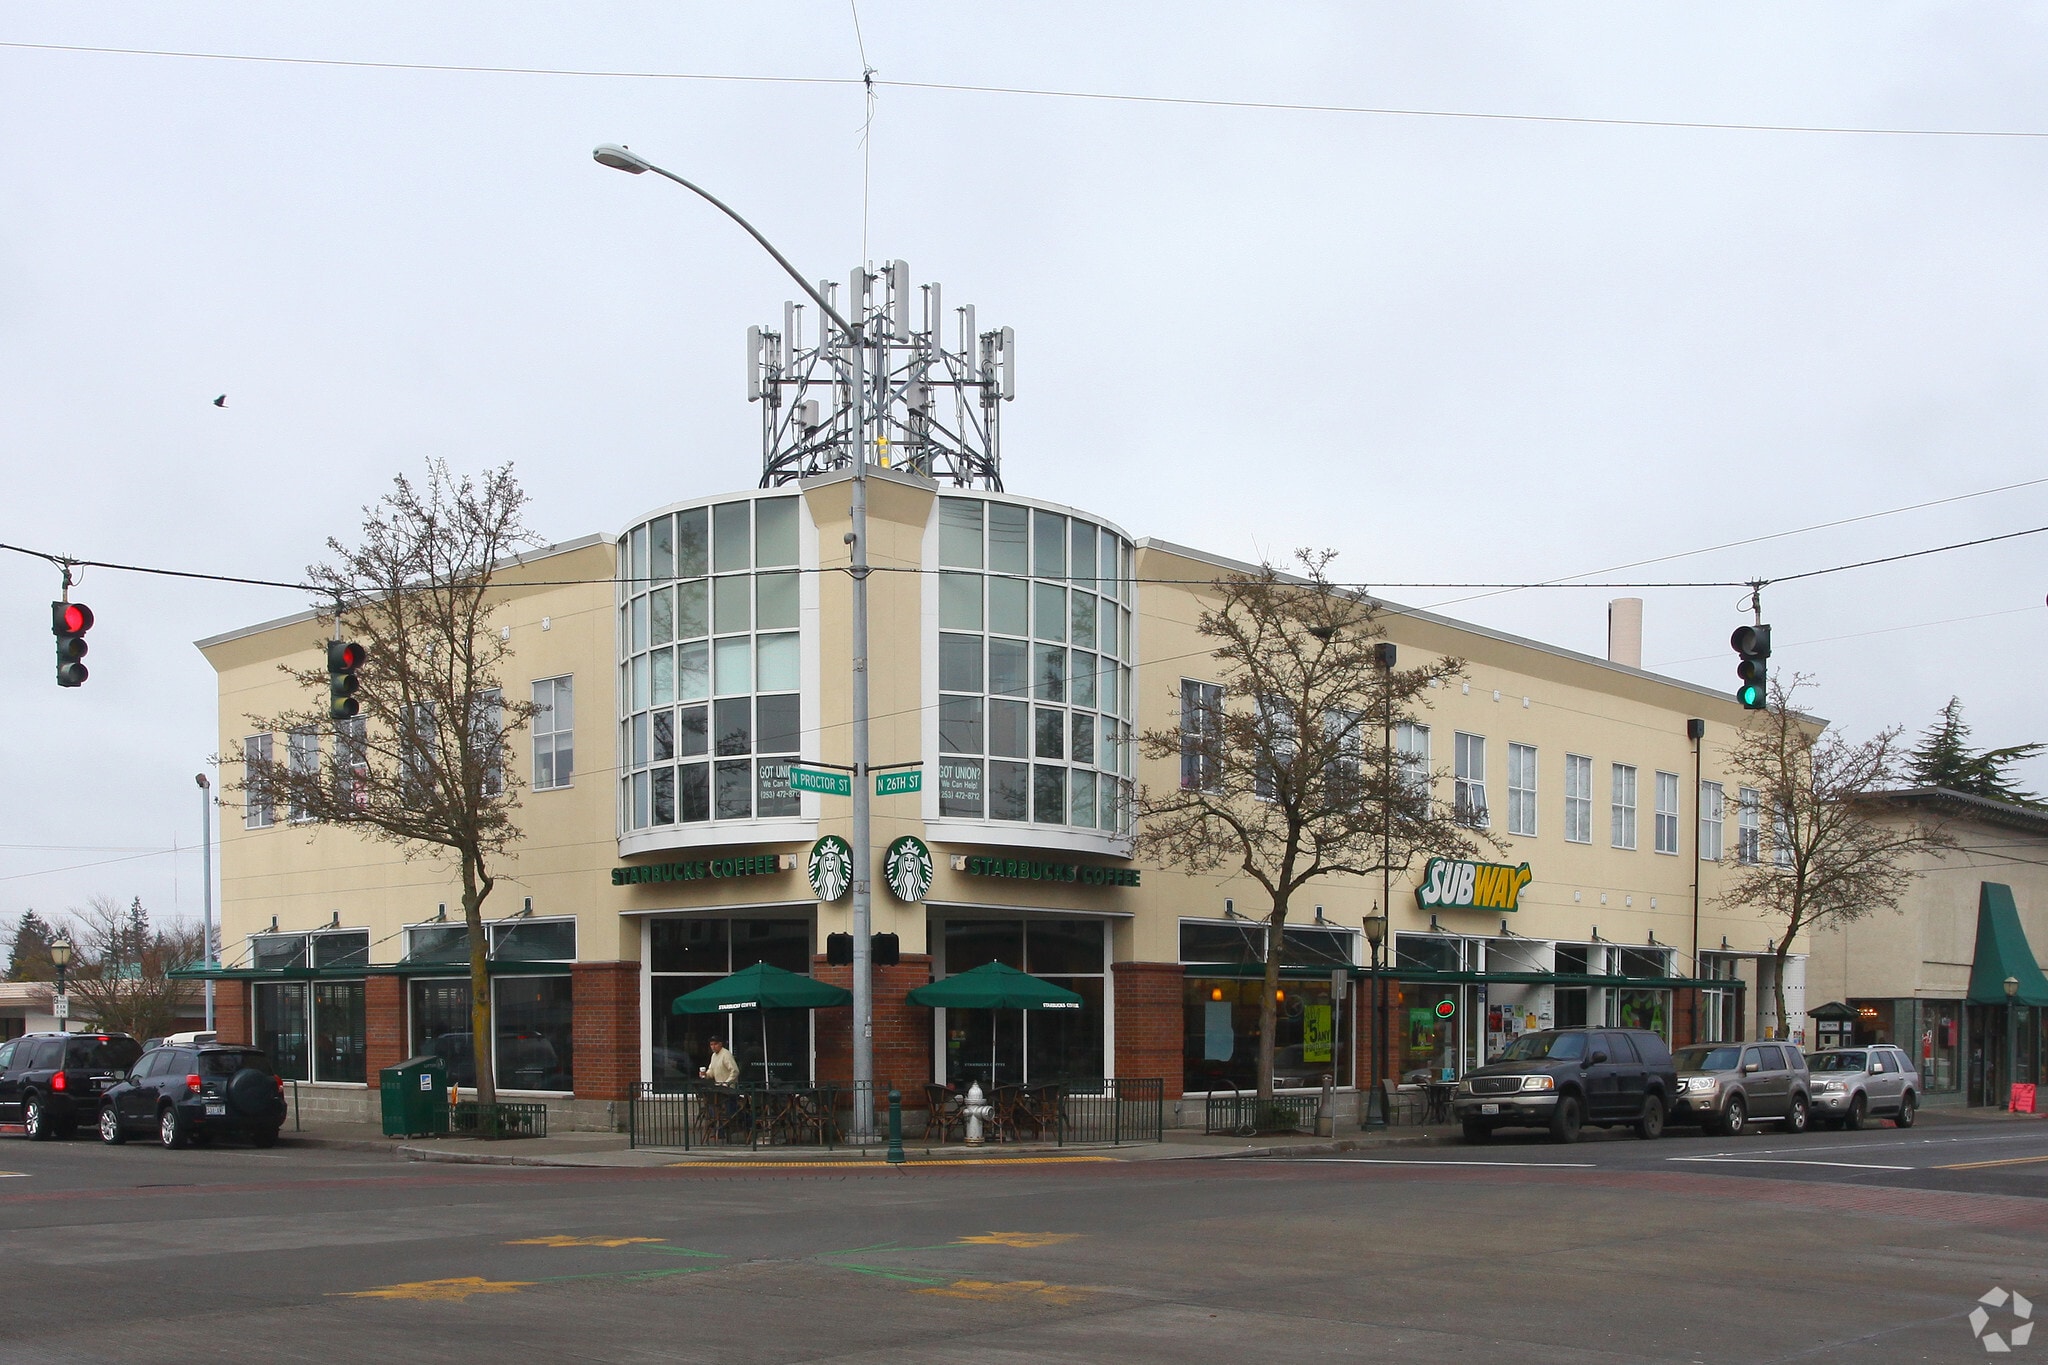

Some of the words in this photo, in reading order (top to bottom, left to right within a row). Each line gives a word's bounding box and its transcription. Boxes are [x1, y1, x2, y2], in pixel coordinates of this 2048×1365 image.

[760, 766, 773, 779] GOT
[775, 765, 793, 778] UNI
[939, 765, 953, 778] GOT
[955, 766, 981, 780] UNION?
[762, 780, 771, 788] We
[772, 779, 783, 787] Can
[791, 772, 798, 785] N
[800, 774, 836, 790] PROCTOR
[838, 779, 849, 792] ST
[877, 779, 884, 792] N
[886, 776, 906, 791] 26TH
[909, 775, 919, 788] ST
[951, 780, 963, 788] Can
[964, 781, 978, 789] Help!
[760, 791, 775, 800] (253)
[940, 790, 954, 799] 253)
[955, 791, 980, 800] 472-8712
[611, 861, 706, 886] STARBUCKS
[709, 854, 778, 879] COFFEE
[969, 855, 1077, 883] STARBUCKS
[1080, 864, 1141, 888] COFFEE
[1421, 860, 1531, 909] SUBWAY
